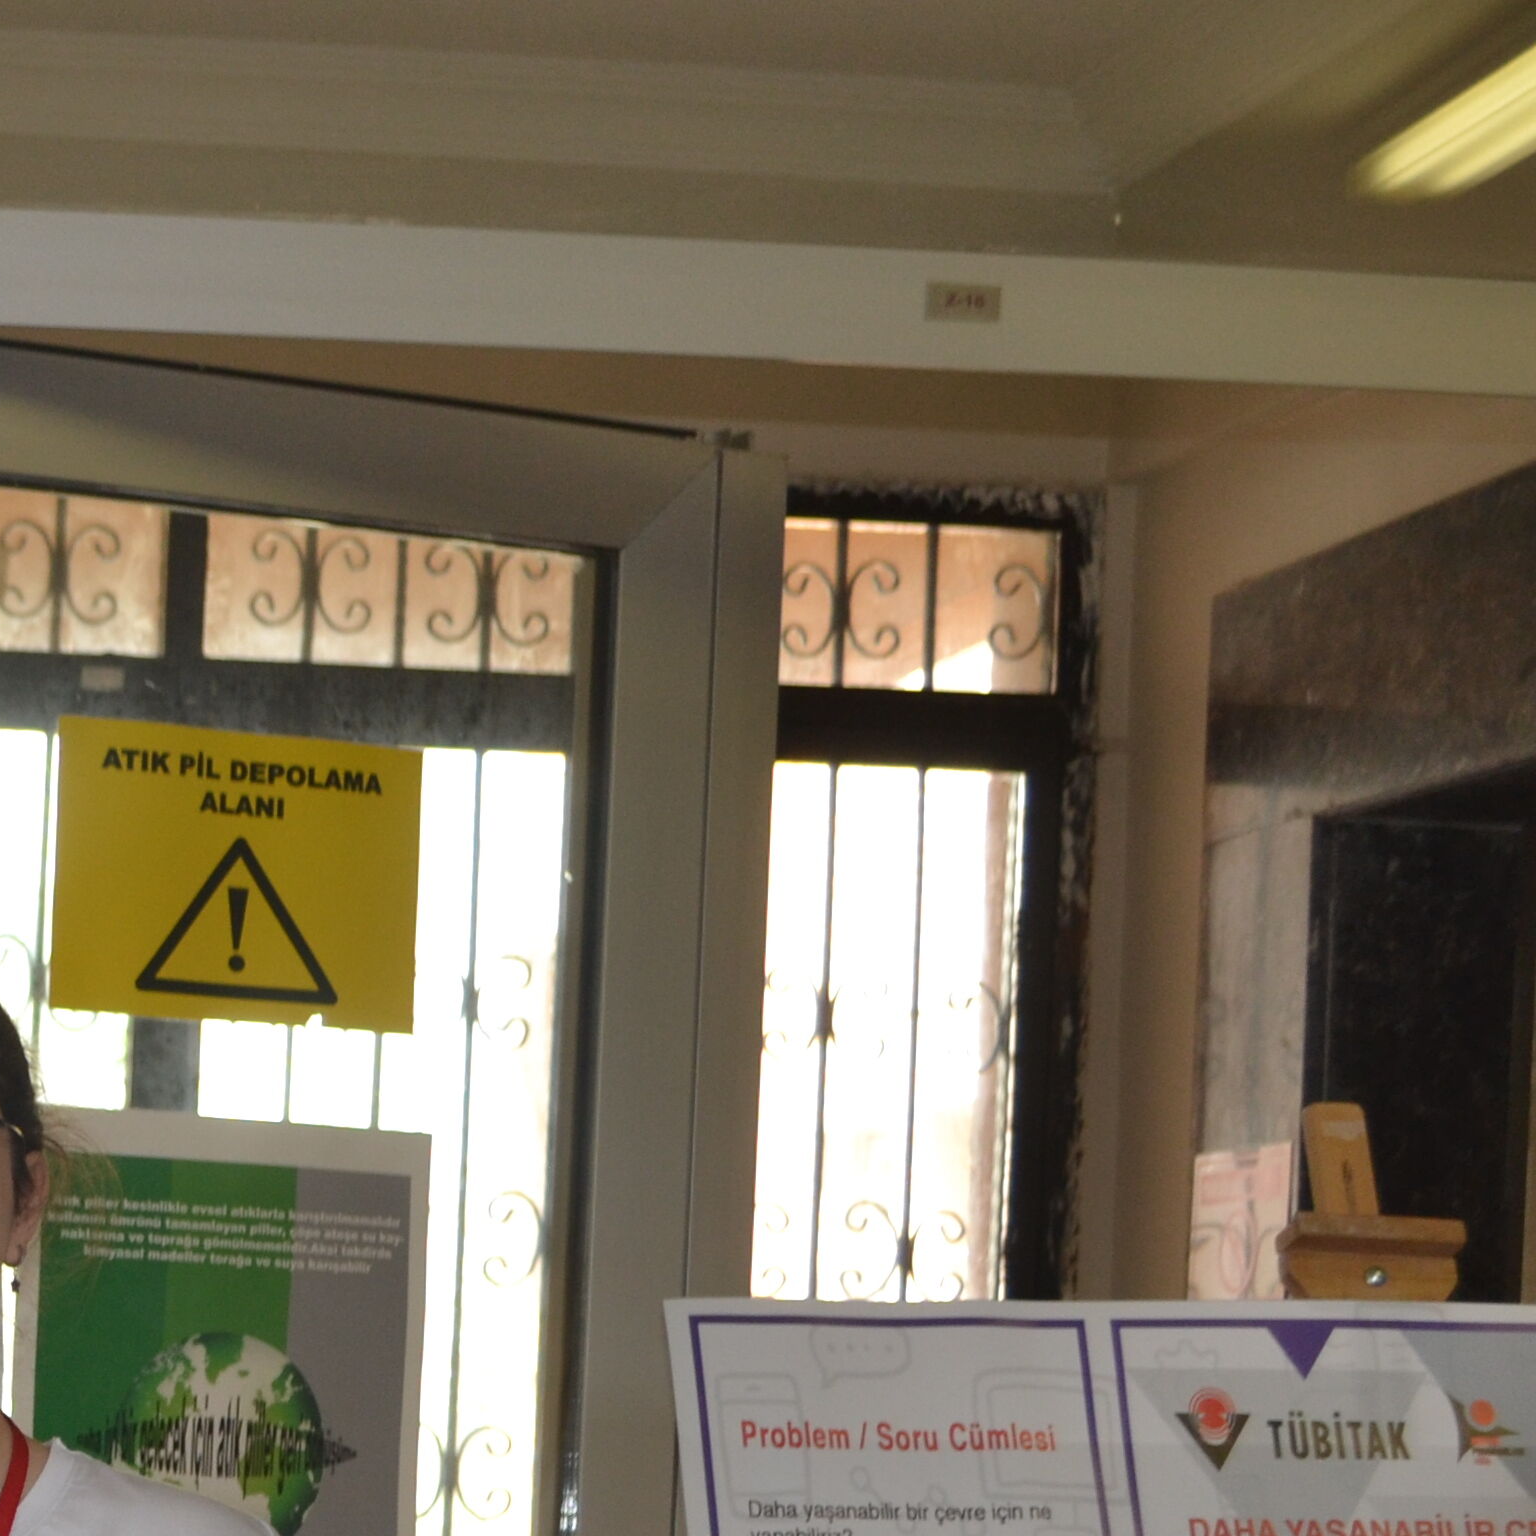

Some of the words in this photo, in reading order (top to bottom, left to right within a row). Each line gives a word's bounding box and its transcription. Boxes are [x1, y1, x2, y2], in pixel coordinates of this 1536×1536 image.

[102, 747, 170, 774] ATIK
[179, 752, 221, 779] PİL
[230, 760, 382, 795] DEPOLAMA
[200, 792, 285, 819] ALANI
[740, 1420, 850, 1450] Problem
[877, 1423, 938, 1451] Soru
[948, 1423, 1056, 1452] Cümlesi
[1267, 1411, 1411, 1461] TÜBİTAK
[748, 1500, 798, 1519] Daha
[803, 1501, 901, 1525] yaşanabilir
[906, 1502, 928, 1520] bir
[934, 1507, 986, 1525] çevre
[992, 1503, 1023, 1525] için
[1030, 1507, 1051, 1520] ne
